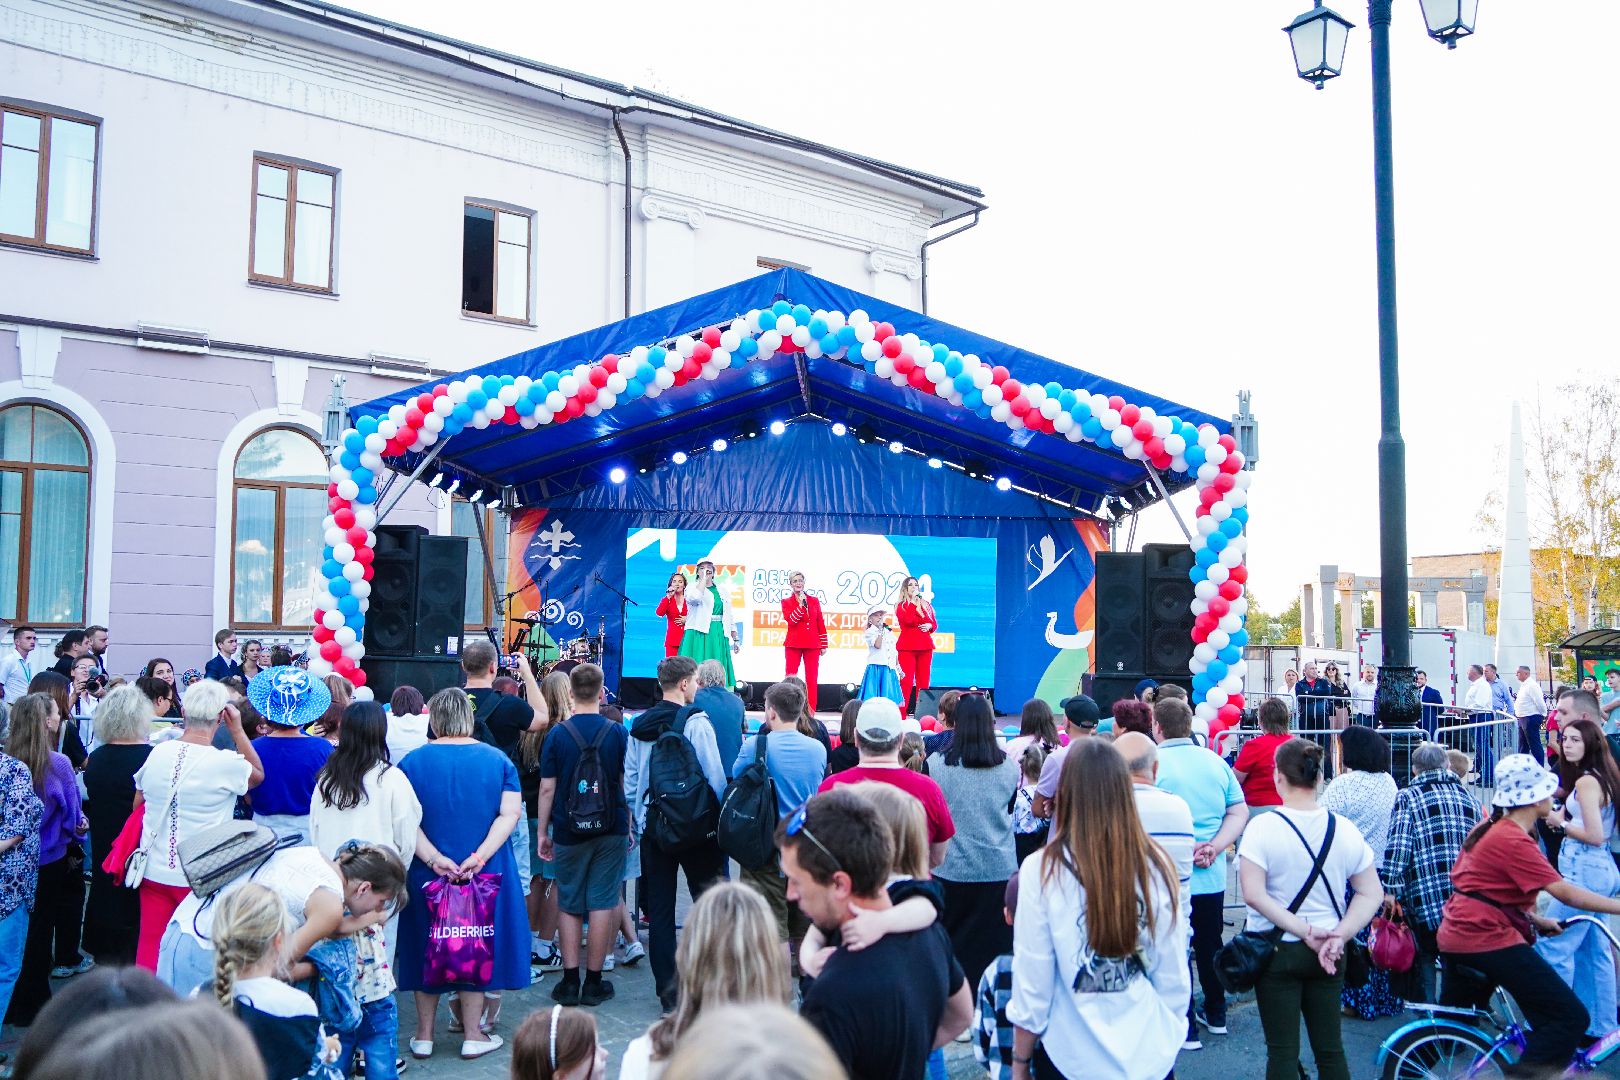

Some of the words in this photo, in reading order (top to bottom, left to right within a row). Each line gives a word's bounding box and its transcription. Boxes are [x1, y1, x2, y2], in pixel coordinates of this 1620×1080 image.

[753, 569, 797, 586] ДЕН
[753, 587, 827, 605] ОКРГА
[836, 571, 935, 606] 2024
[760, 611, 837, 627] ПРАИК
